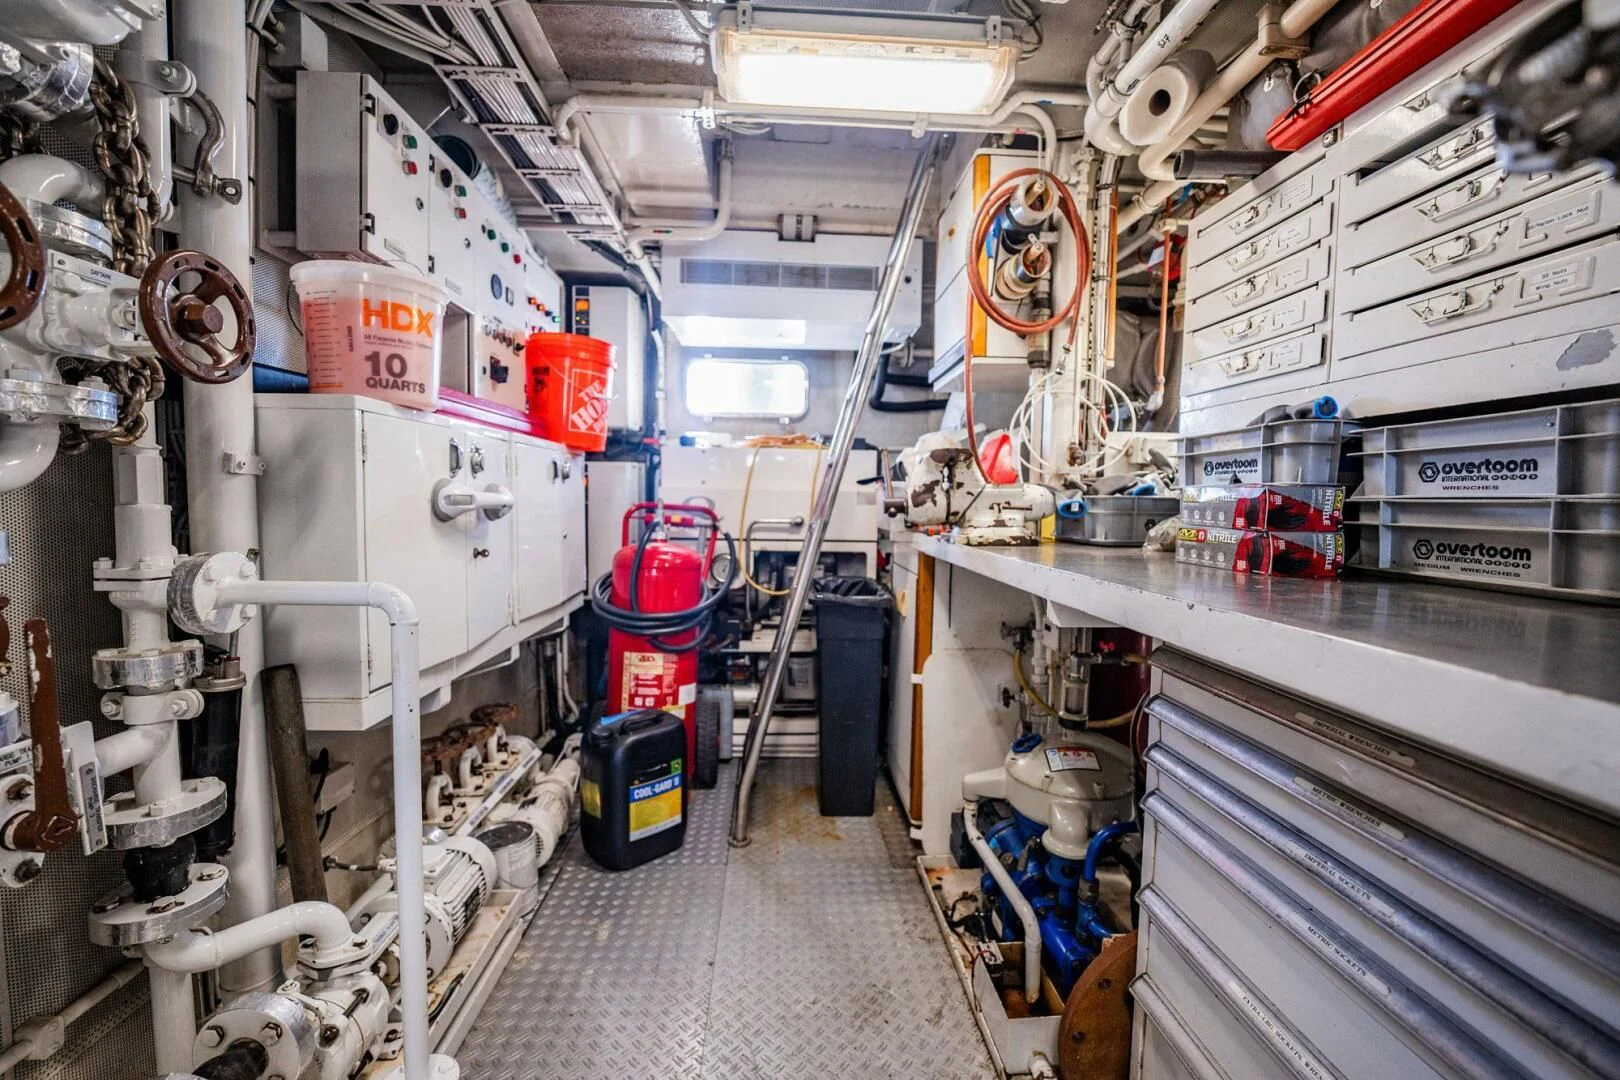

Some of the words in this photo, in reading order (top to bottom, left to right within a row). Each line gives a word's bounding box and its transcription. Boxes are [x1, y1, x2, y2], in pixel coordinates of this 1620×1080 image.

[1557, 212, 1573, 221] Lock
[1576, 206, 1589, 214] Nut
[362, 297, 433, 338] HDX
[364, 351, 408, 379] 10
[365, 377, 426, 394] QUARTS
[1214, 458, 1258, 469] overtoom
[1441, 458, 1539, 475] overtoom
[1441, 474, 1490, 482] INTERNATIONAL
[1322, 489, 1335, 526] NITRILE
[1206, 531, 1237, 543] NITRILE
[1324, 534, 1335, 570] NITRILE
[1435, 541, 1532, 561] overtoom
[1435, 555, 1484, 565] INTERNATIONAL
[1413, 562, 1451, 570] MEDIUM
[1459, 567, 1521, 578] WRENCHES
[1313, 720, 1346, 738] IMPERIAL
[1348, 734, 1391, 756] WRENCHES
[633, 779, 673, 800] COOL-GARD
[1312, 786, 1338, 805] METRIC
[1339, 801, 1380, 827] WRENCHES
[1304, 853, 1336, 877] IMPERIAL
[1338, 875, 1372, 901] SOCKETS
[1307, 926, 1333, 949] METRIC
[1334, 947, 1367, 977] SOCKETS
